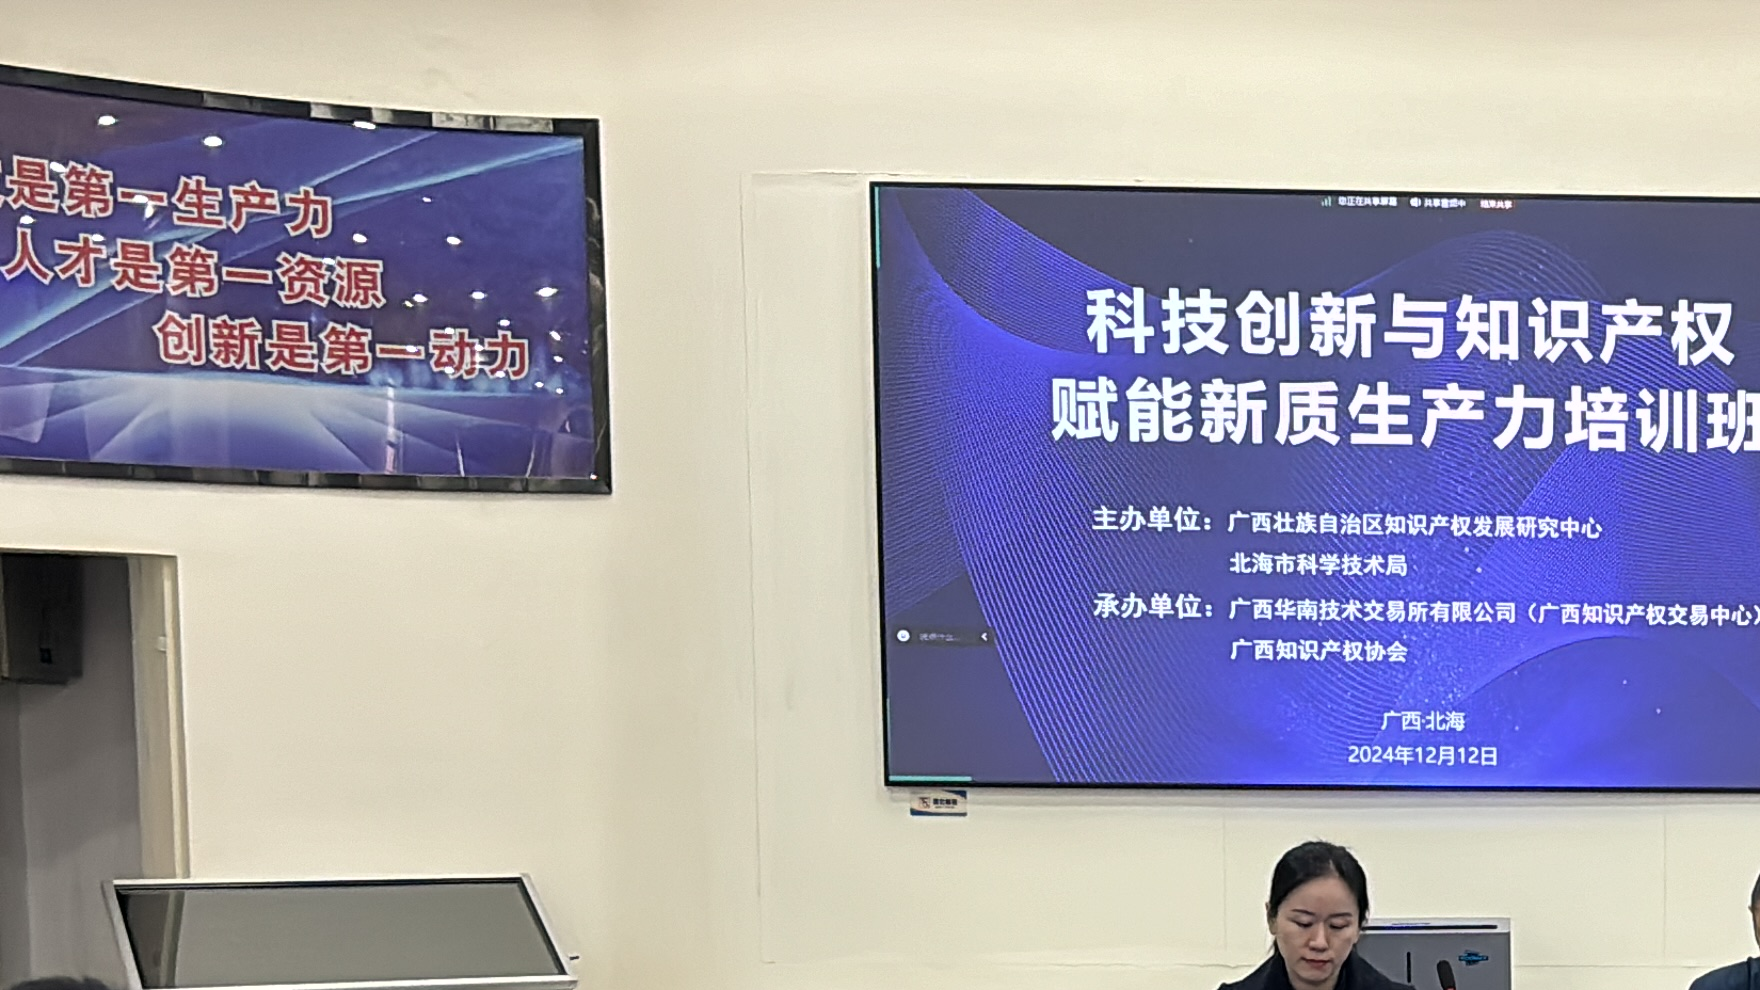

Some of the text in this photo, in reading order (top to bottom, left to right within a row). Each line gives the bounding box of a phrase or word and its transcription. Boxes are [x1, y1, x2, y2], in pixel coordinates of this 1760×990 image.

[0, 155, 332, 238] 是第一生产力
[1, 227, 386, 310] 人才是第一资源
[1085, 287, 1736, 367] 科技创新与知识产权
[152, 311, 530, 380] 创新是第一动力
[1092, 506, 1603, 539] 主办单位： 广西壮族自治区知识产权发展研究中心
[1229, 553, 1408, 578] 北海市科学技术局
[1093, 593, 1214, 619] 承办单位：
[1230, 639, 1408, 664] 广西知识产权协会
[1381, 711, 1466, 732] 广西·北海
[1348, 745, 1498, 767] 2024年12月12日
